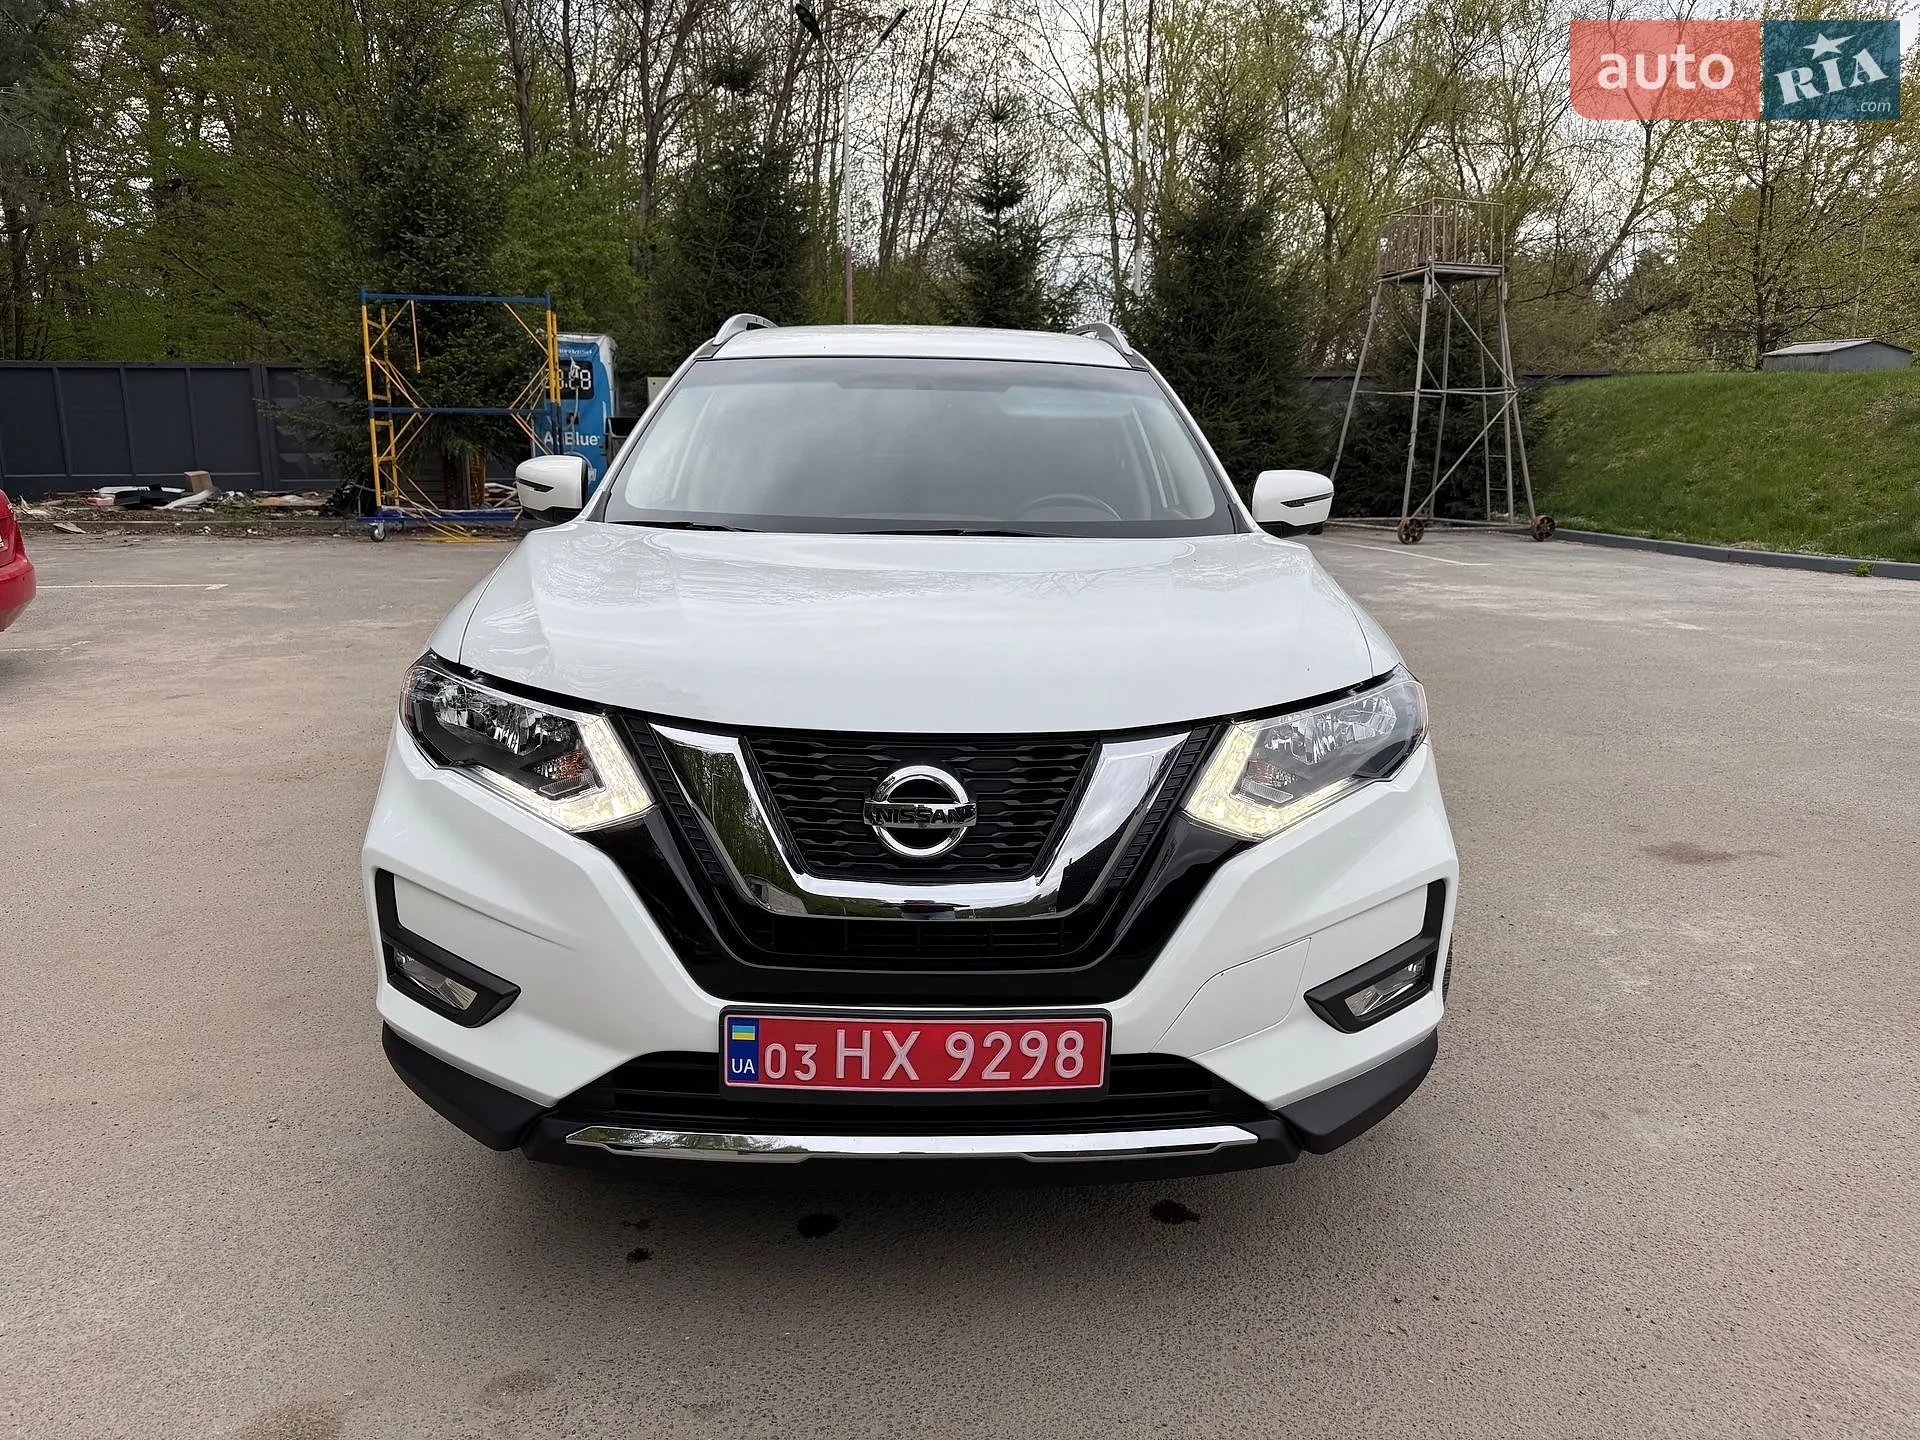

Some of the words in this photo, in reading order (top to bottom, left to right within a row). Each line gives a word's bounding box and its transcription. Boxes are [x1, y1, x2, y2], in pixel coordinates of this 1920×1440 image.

[544, 431, 599, 446] ABlue
[876, 807, 970, 824] NISSAN
[764, 1043, 817, 1081] 03
[835, 1029, 921, 1081] HX
[944, 1030, 1085, 1081] 9298
[731, 1058, 755, 1074] UA
